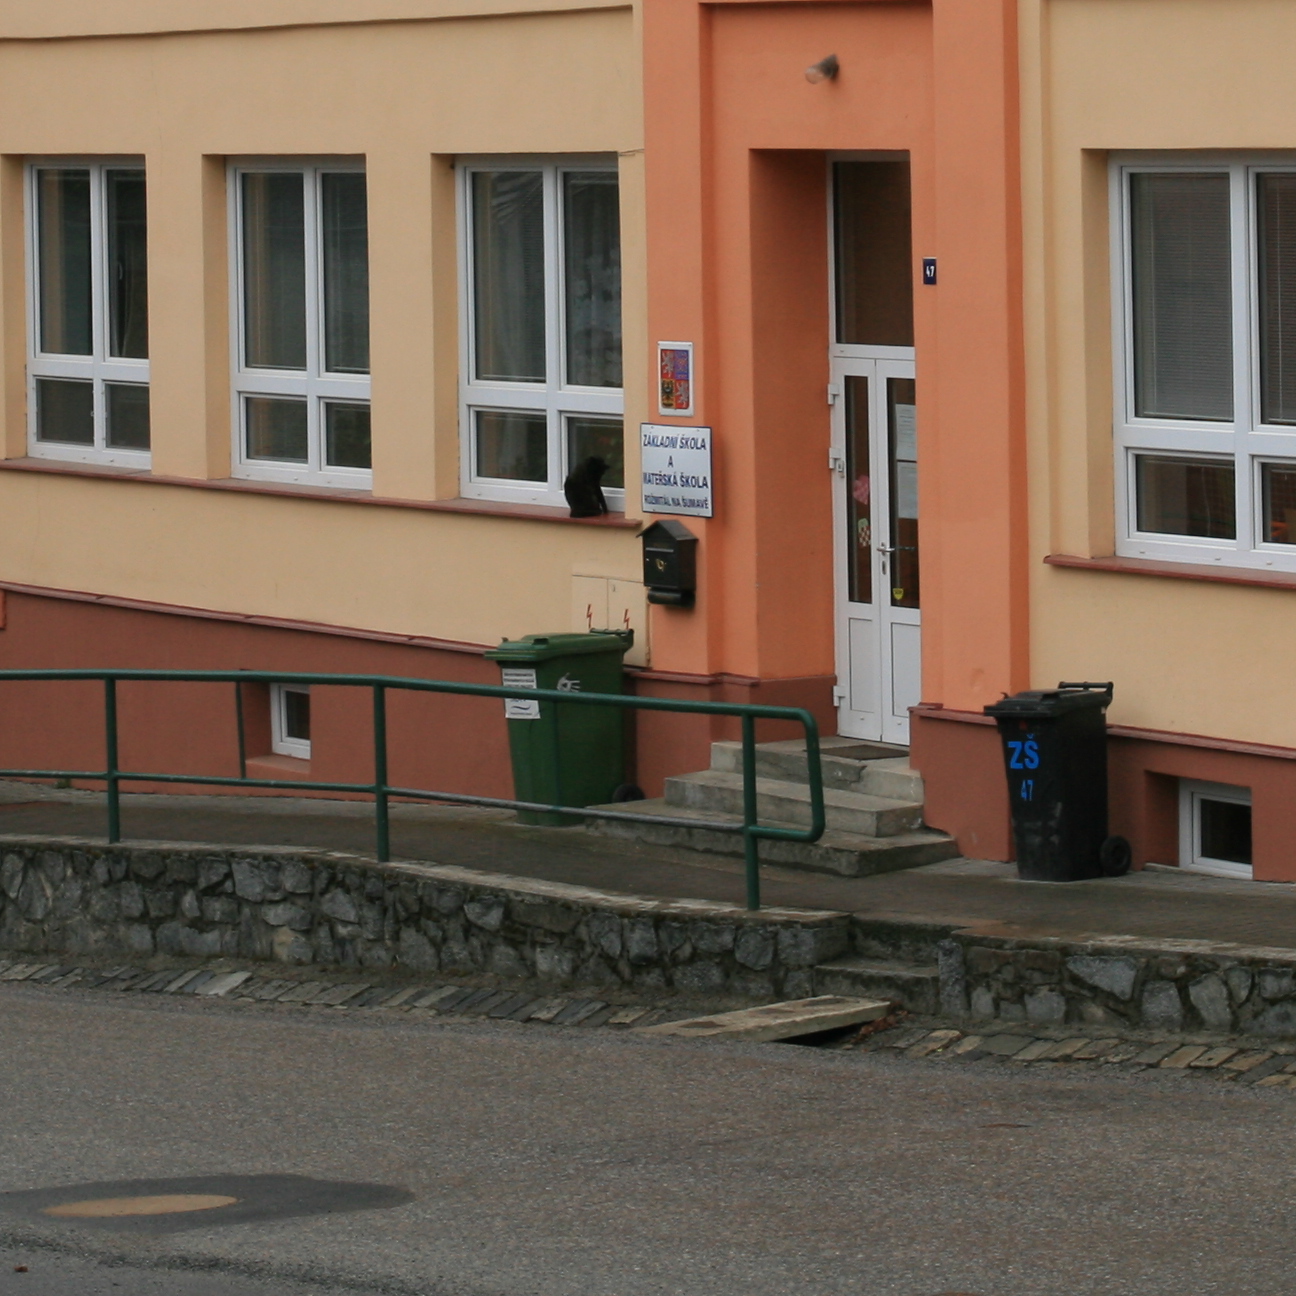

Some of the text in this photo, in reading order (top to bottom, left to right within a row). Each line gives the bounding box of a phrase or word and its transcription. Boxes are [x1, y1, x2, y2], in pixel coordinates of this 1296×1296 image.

[926, 265, 935, 277] 47
[643, 432, 706, 450] ZÁKLADNÍ ŠKOLA
[667, 455, 674, 468] A
[643, 470, 709, 489] MATEŘSKÁ ŠKOLA
[1007, 733, 1040, 770] ZŠ
[1020, 779, 1034, 801] 47
